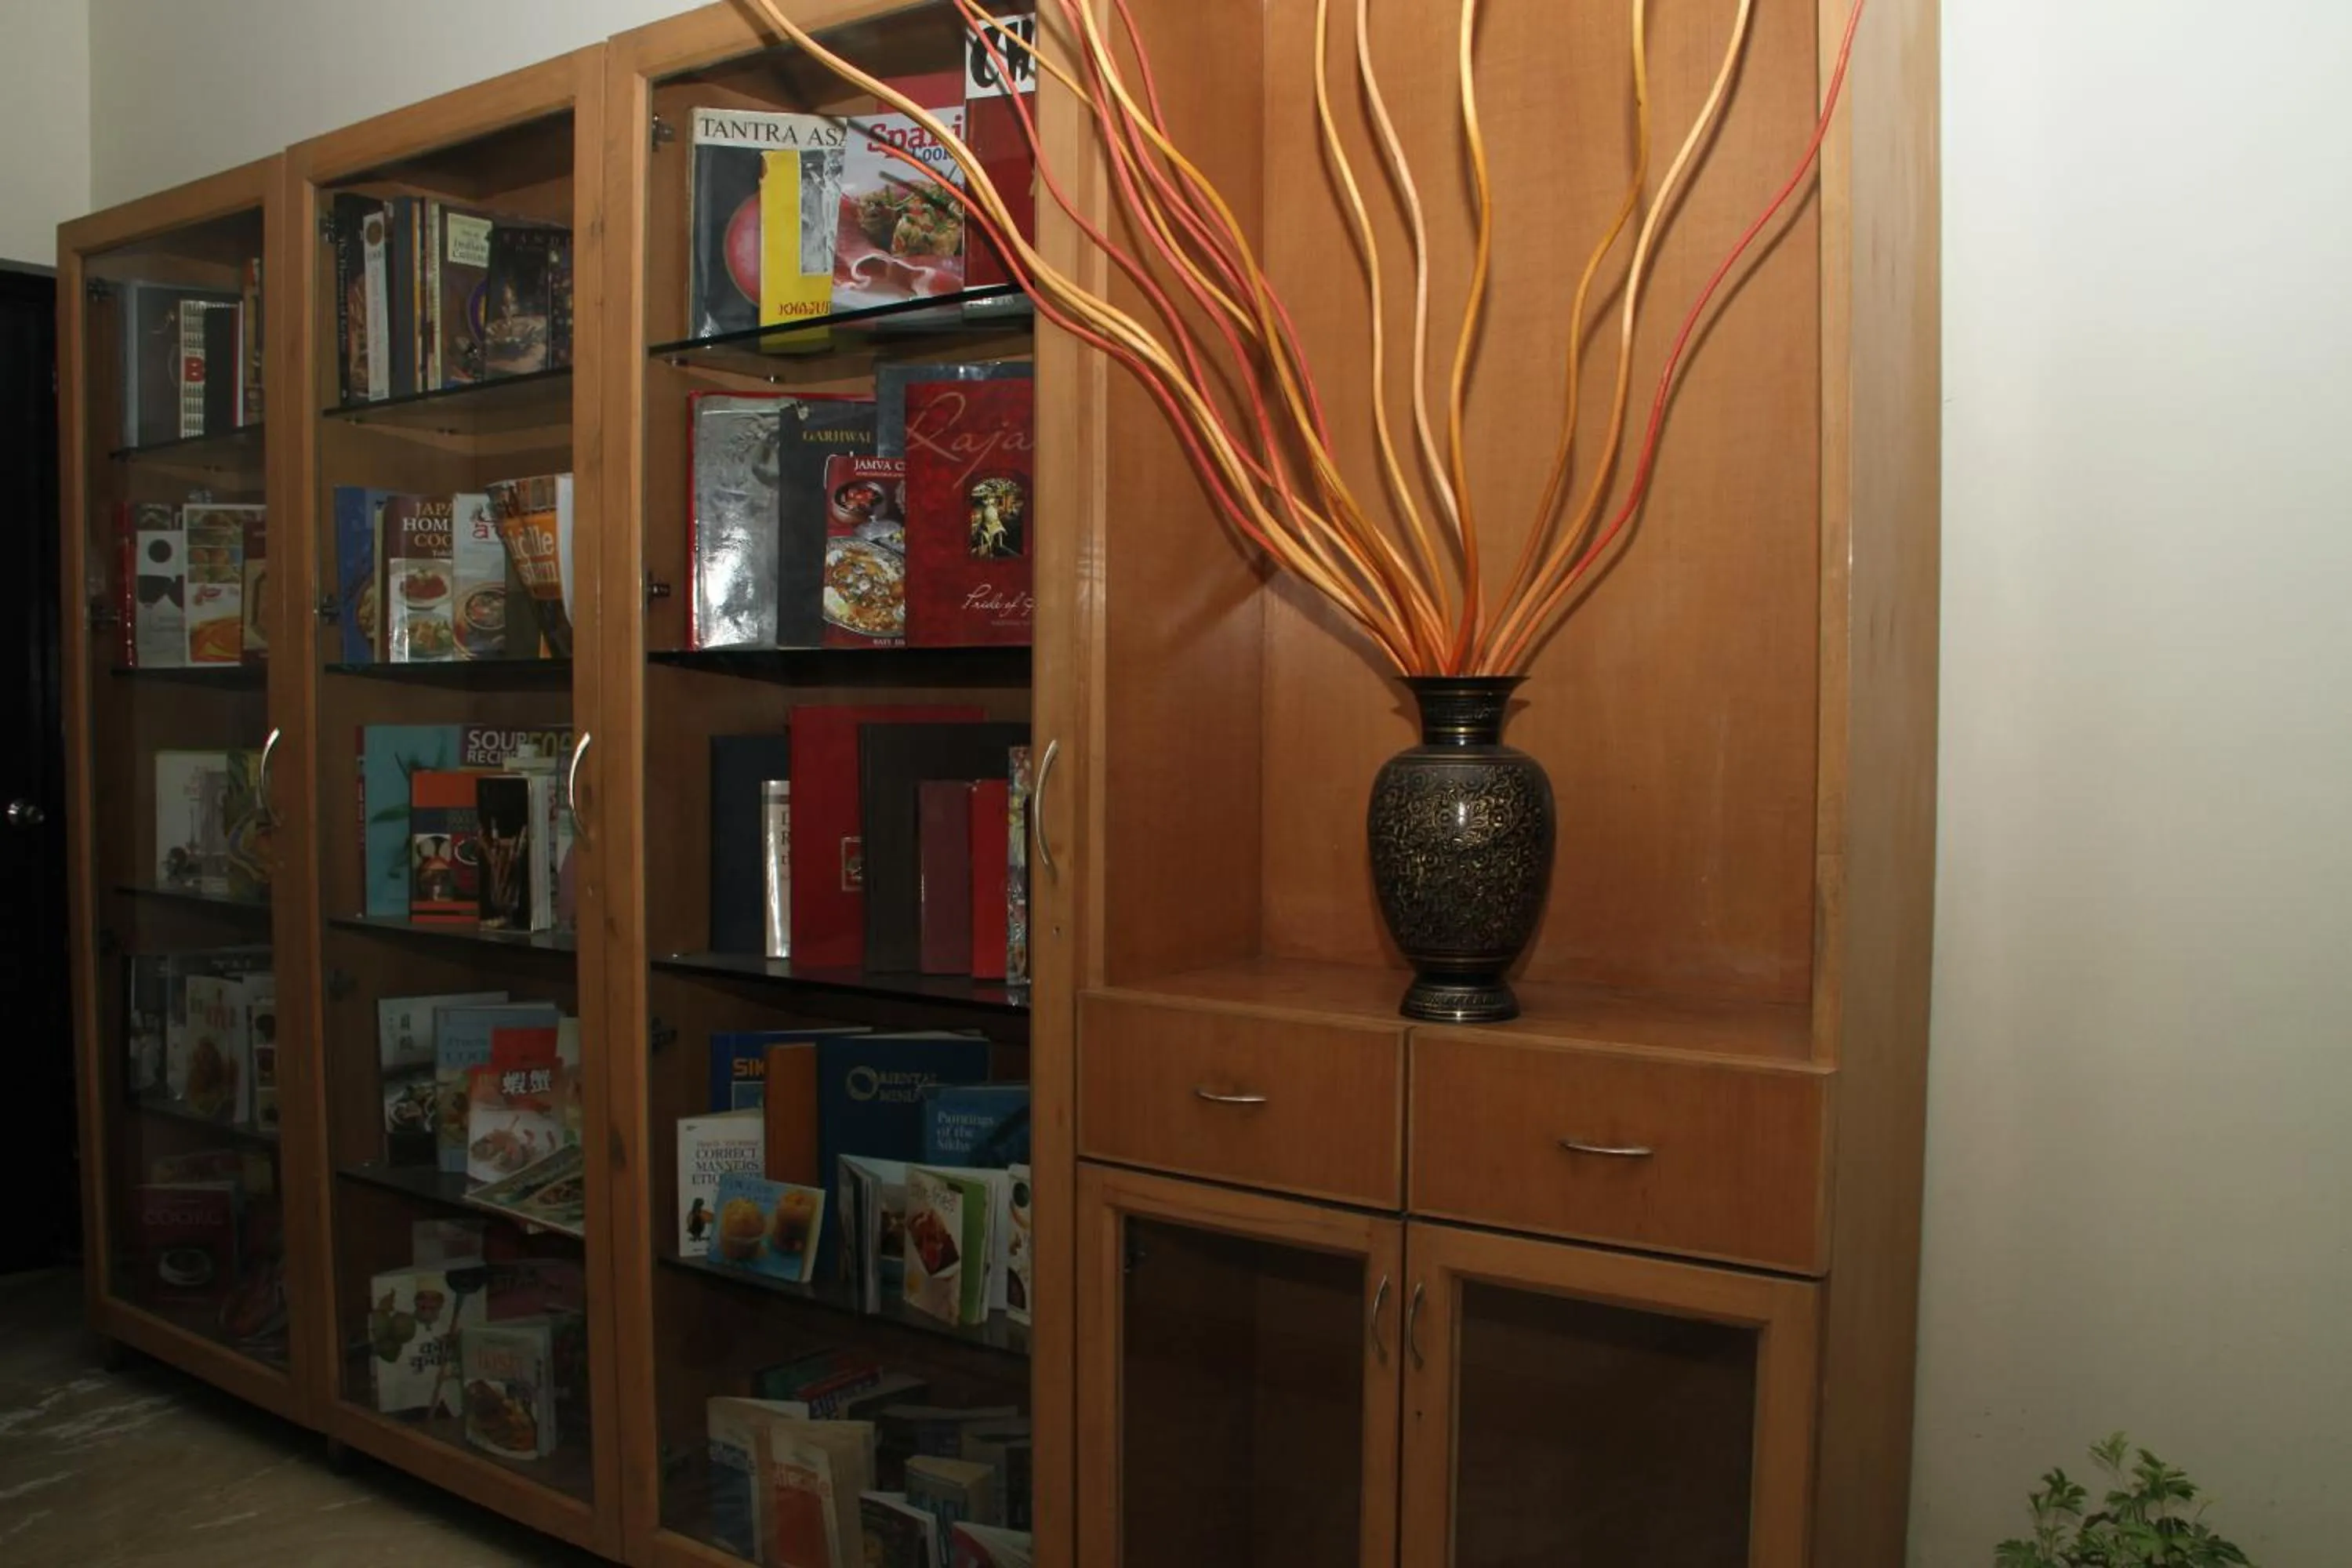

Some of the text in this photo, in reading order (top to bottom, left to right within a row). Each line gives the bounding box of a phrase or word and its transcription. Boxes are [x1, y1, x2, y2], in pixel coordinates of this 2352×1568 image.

[701, 118, 798, 145] TANTRA
[867, 114, 963, 159] Spai
[854, 459, 891, 471] JAMVA
[402, 517, 452, 532] HOM
